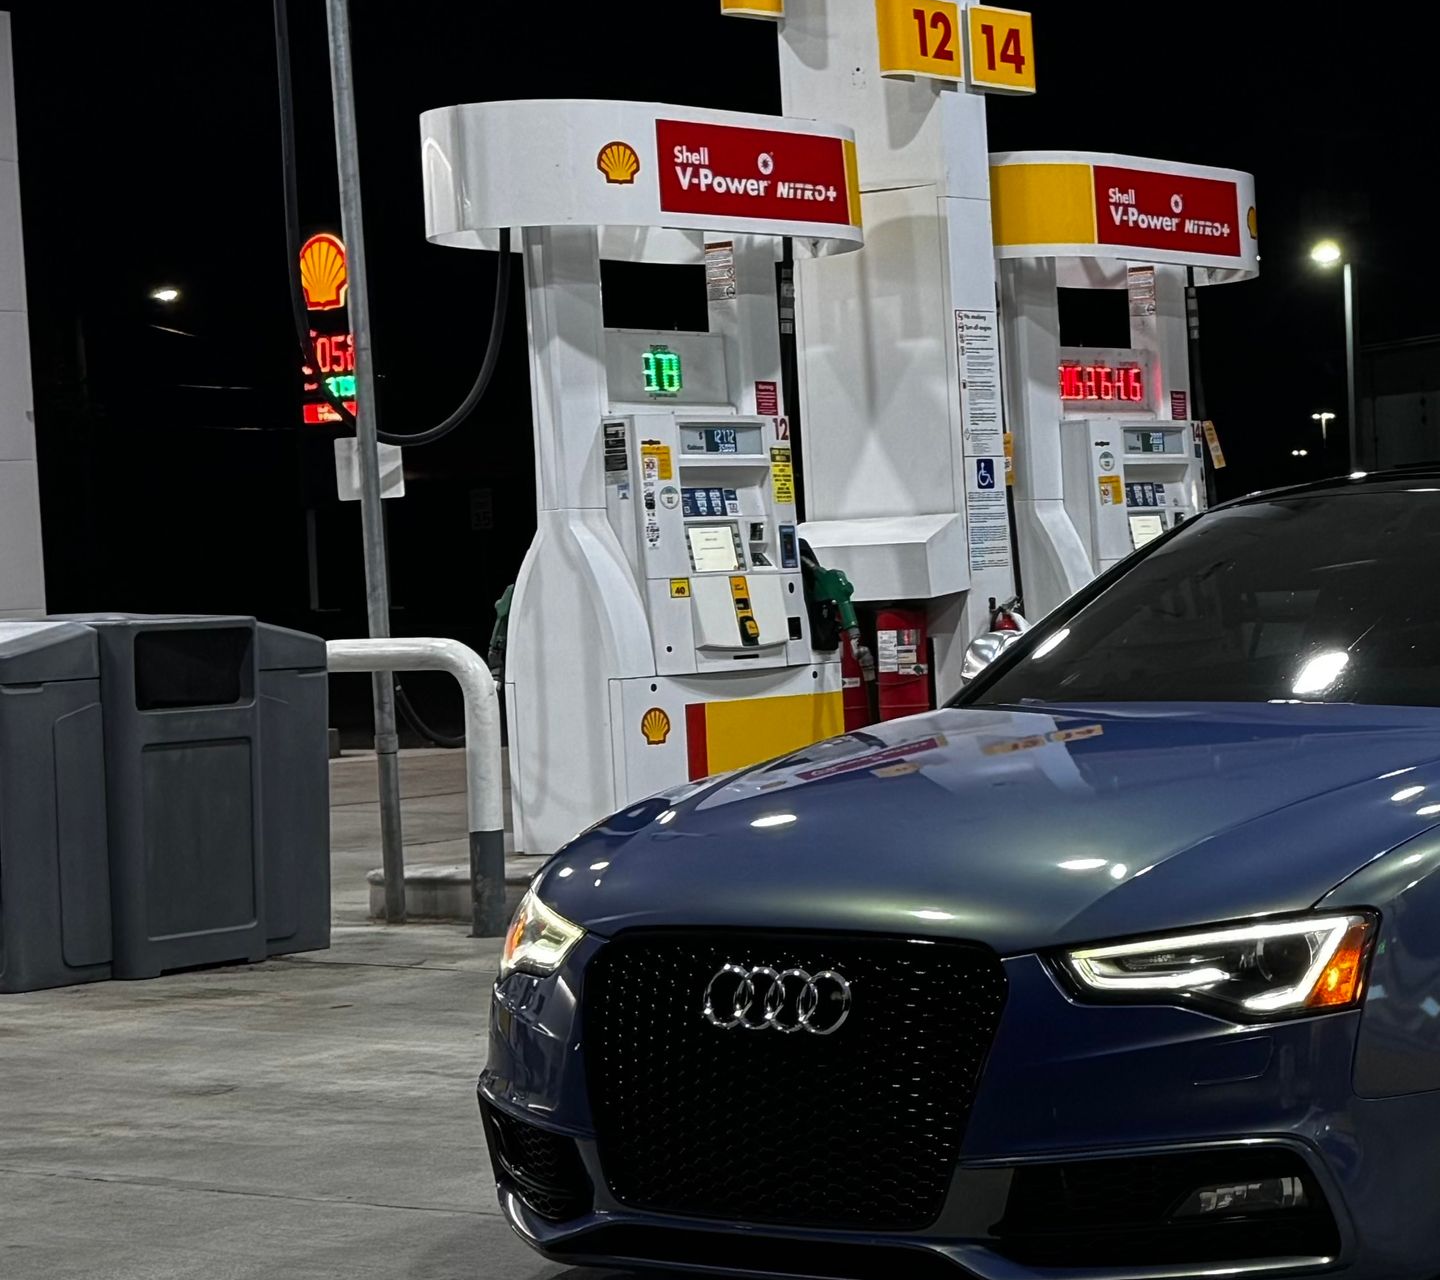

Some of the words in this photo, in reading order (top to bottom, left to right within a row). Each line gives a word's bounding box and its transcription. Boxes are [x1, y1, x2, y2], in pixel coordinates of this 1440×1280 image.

[912, 8, 954, 62] 12
[981, 24, 1026, 74] 14
[673, 145, 709, 166] Shell
[674, 166, 769, 197] V-Power
[1108, 187, 1136, 205] Shell
[1109, 205, 1179, 232] V-Power
[772, 418, 789, 440] 12
[1191, 422, 1202, 442] 14
